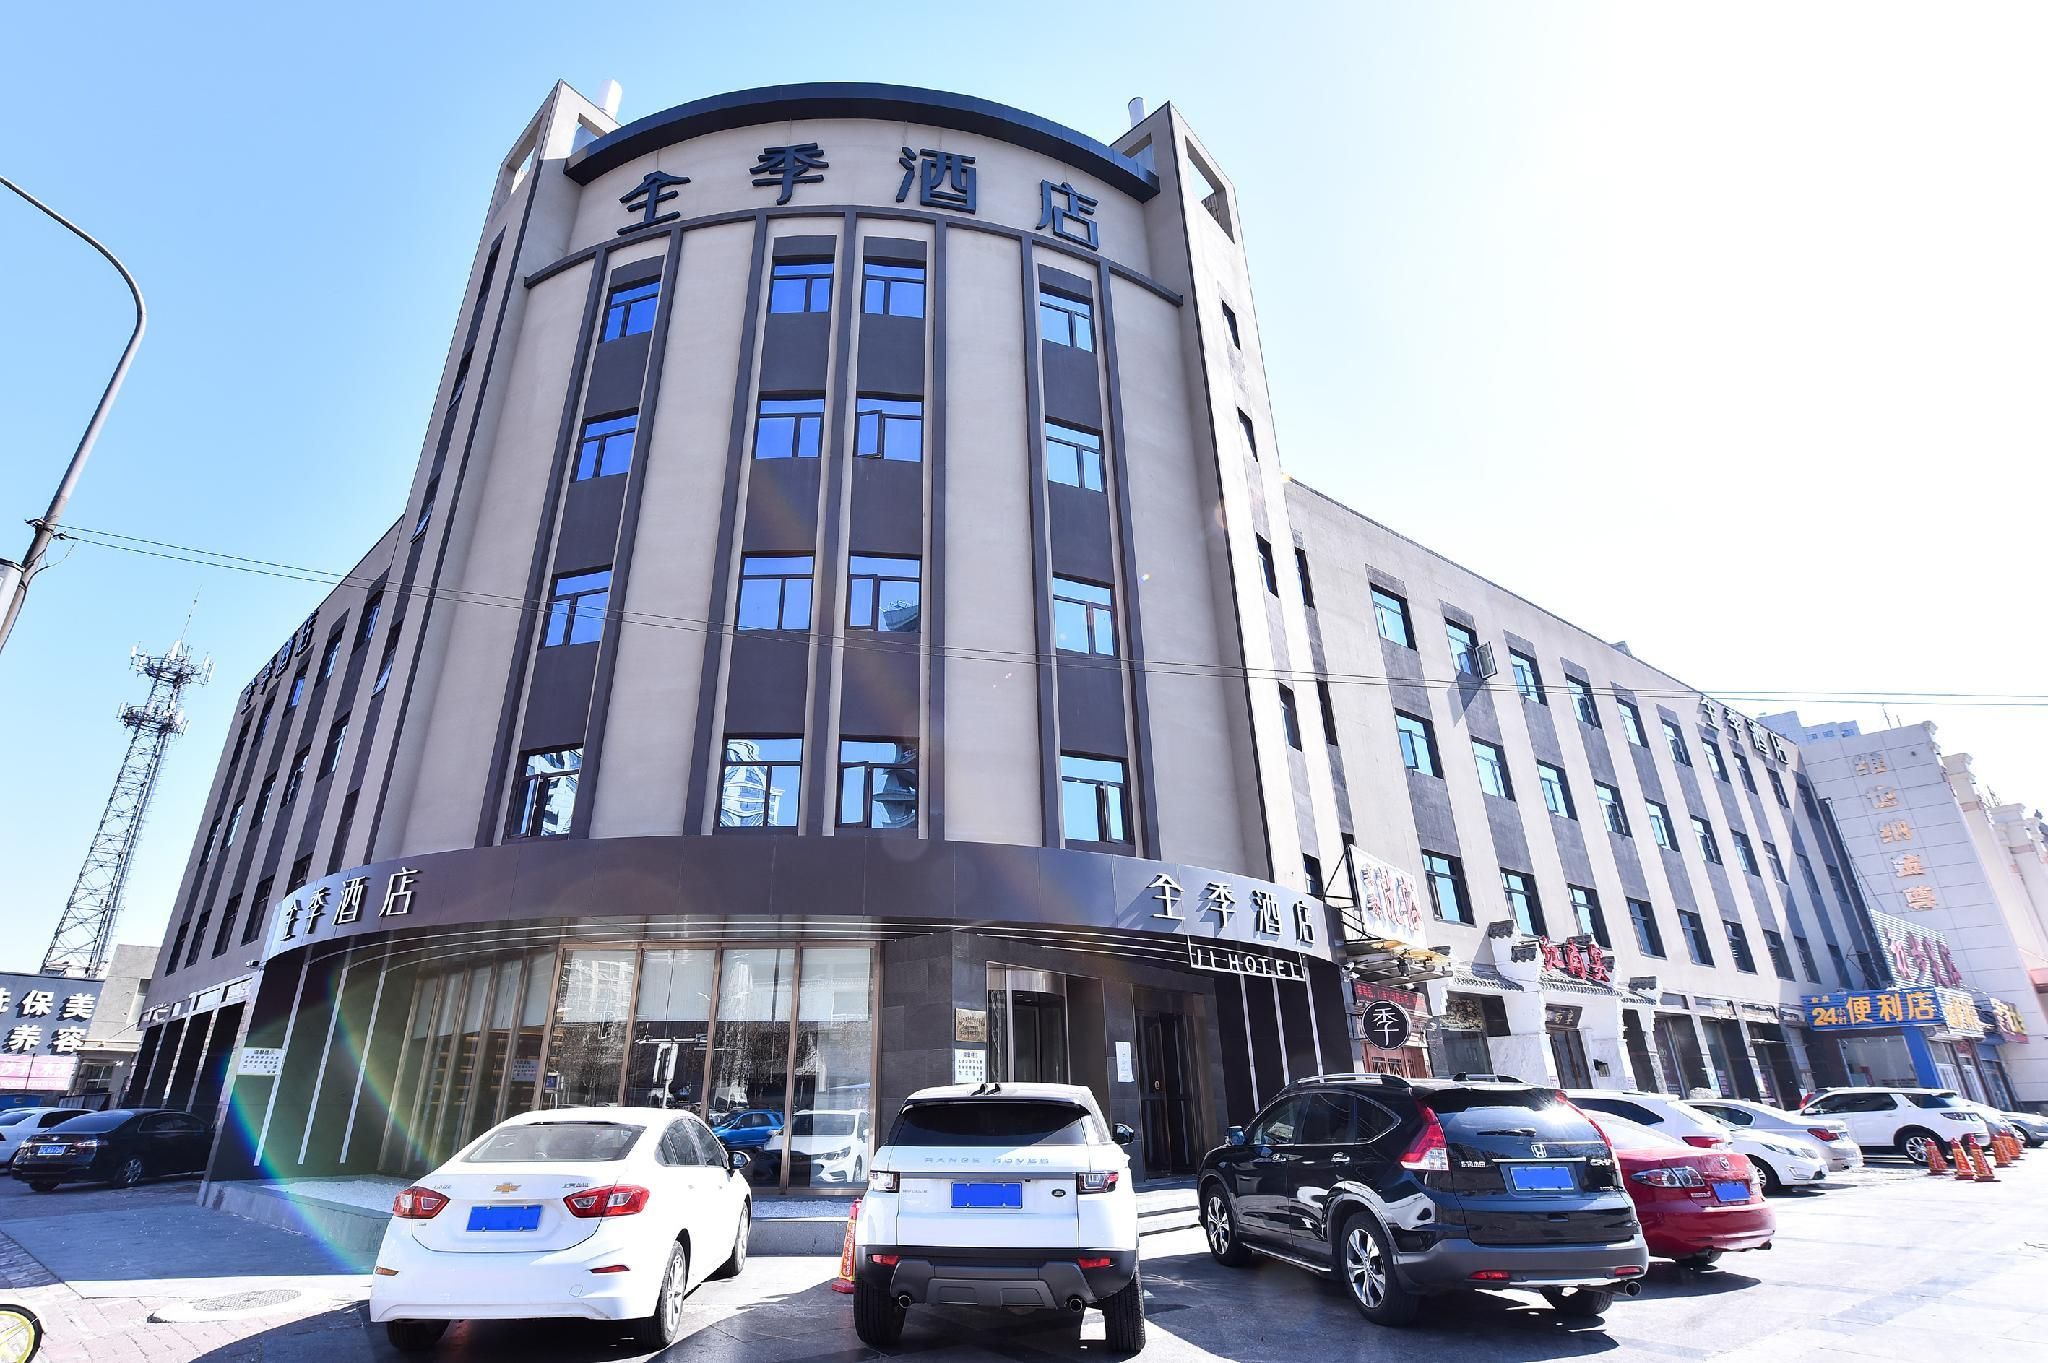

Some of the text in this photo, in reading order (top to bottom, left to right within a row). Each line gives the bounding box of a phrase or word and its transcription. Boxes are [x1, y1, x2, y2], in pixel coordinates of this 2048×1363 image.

[616, 141, 1099, 251] 全季酒店
[280, 866, 419, 941] 全季酒店
[1148, 873, 1315, 944] 全季酒店
[1228, 953, 1300, 978] HOTEL
[1372, 1007, 1400, 1046] 季
[1812, 1007, 1838, 1026] 24
[1846, 991, 1935, 1025] 便利店
[924, 1157, 981, 1165] RANGE
